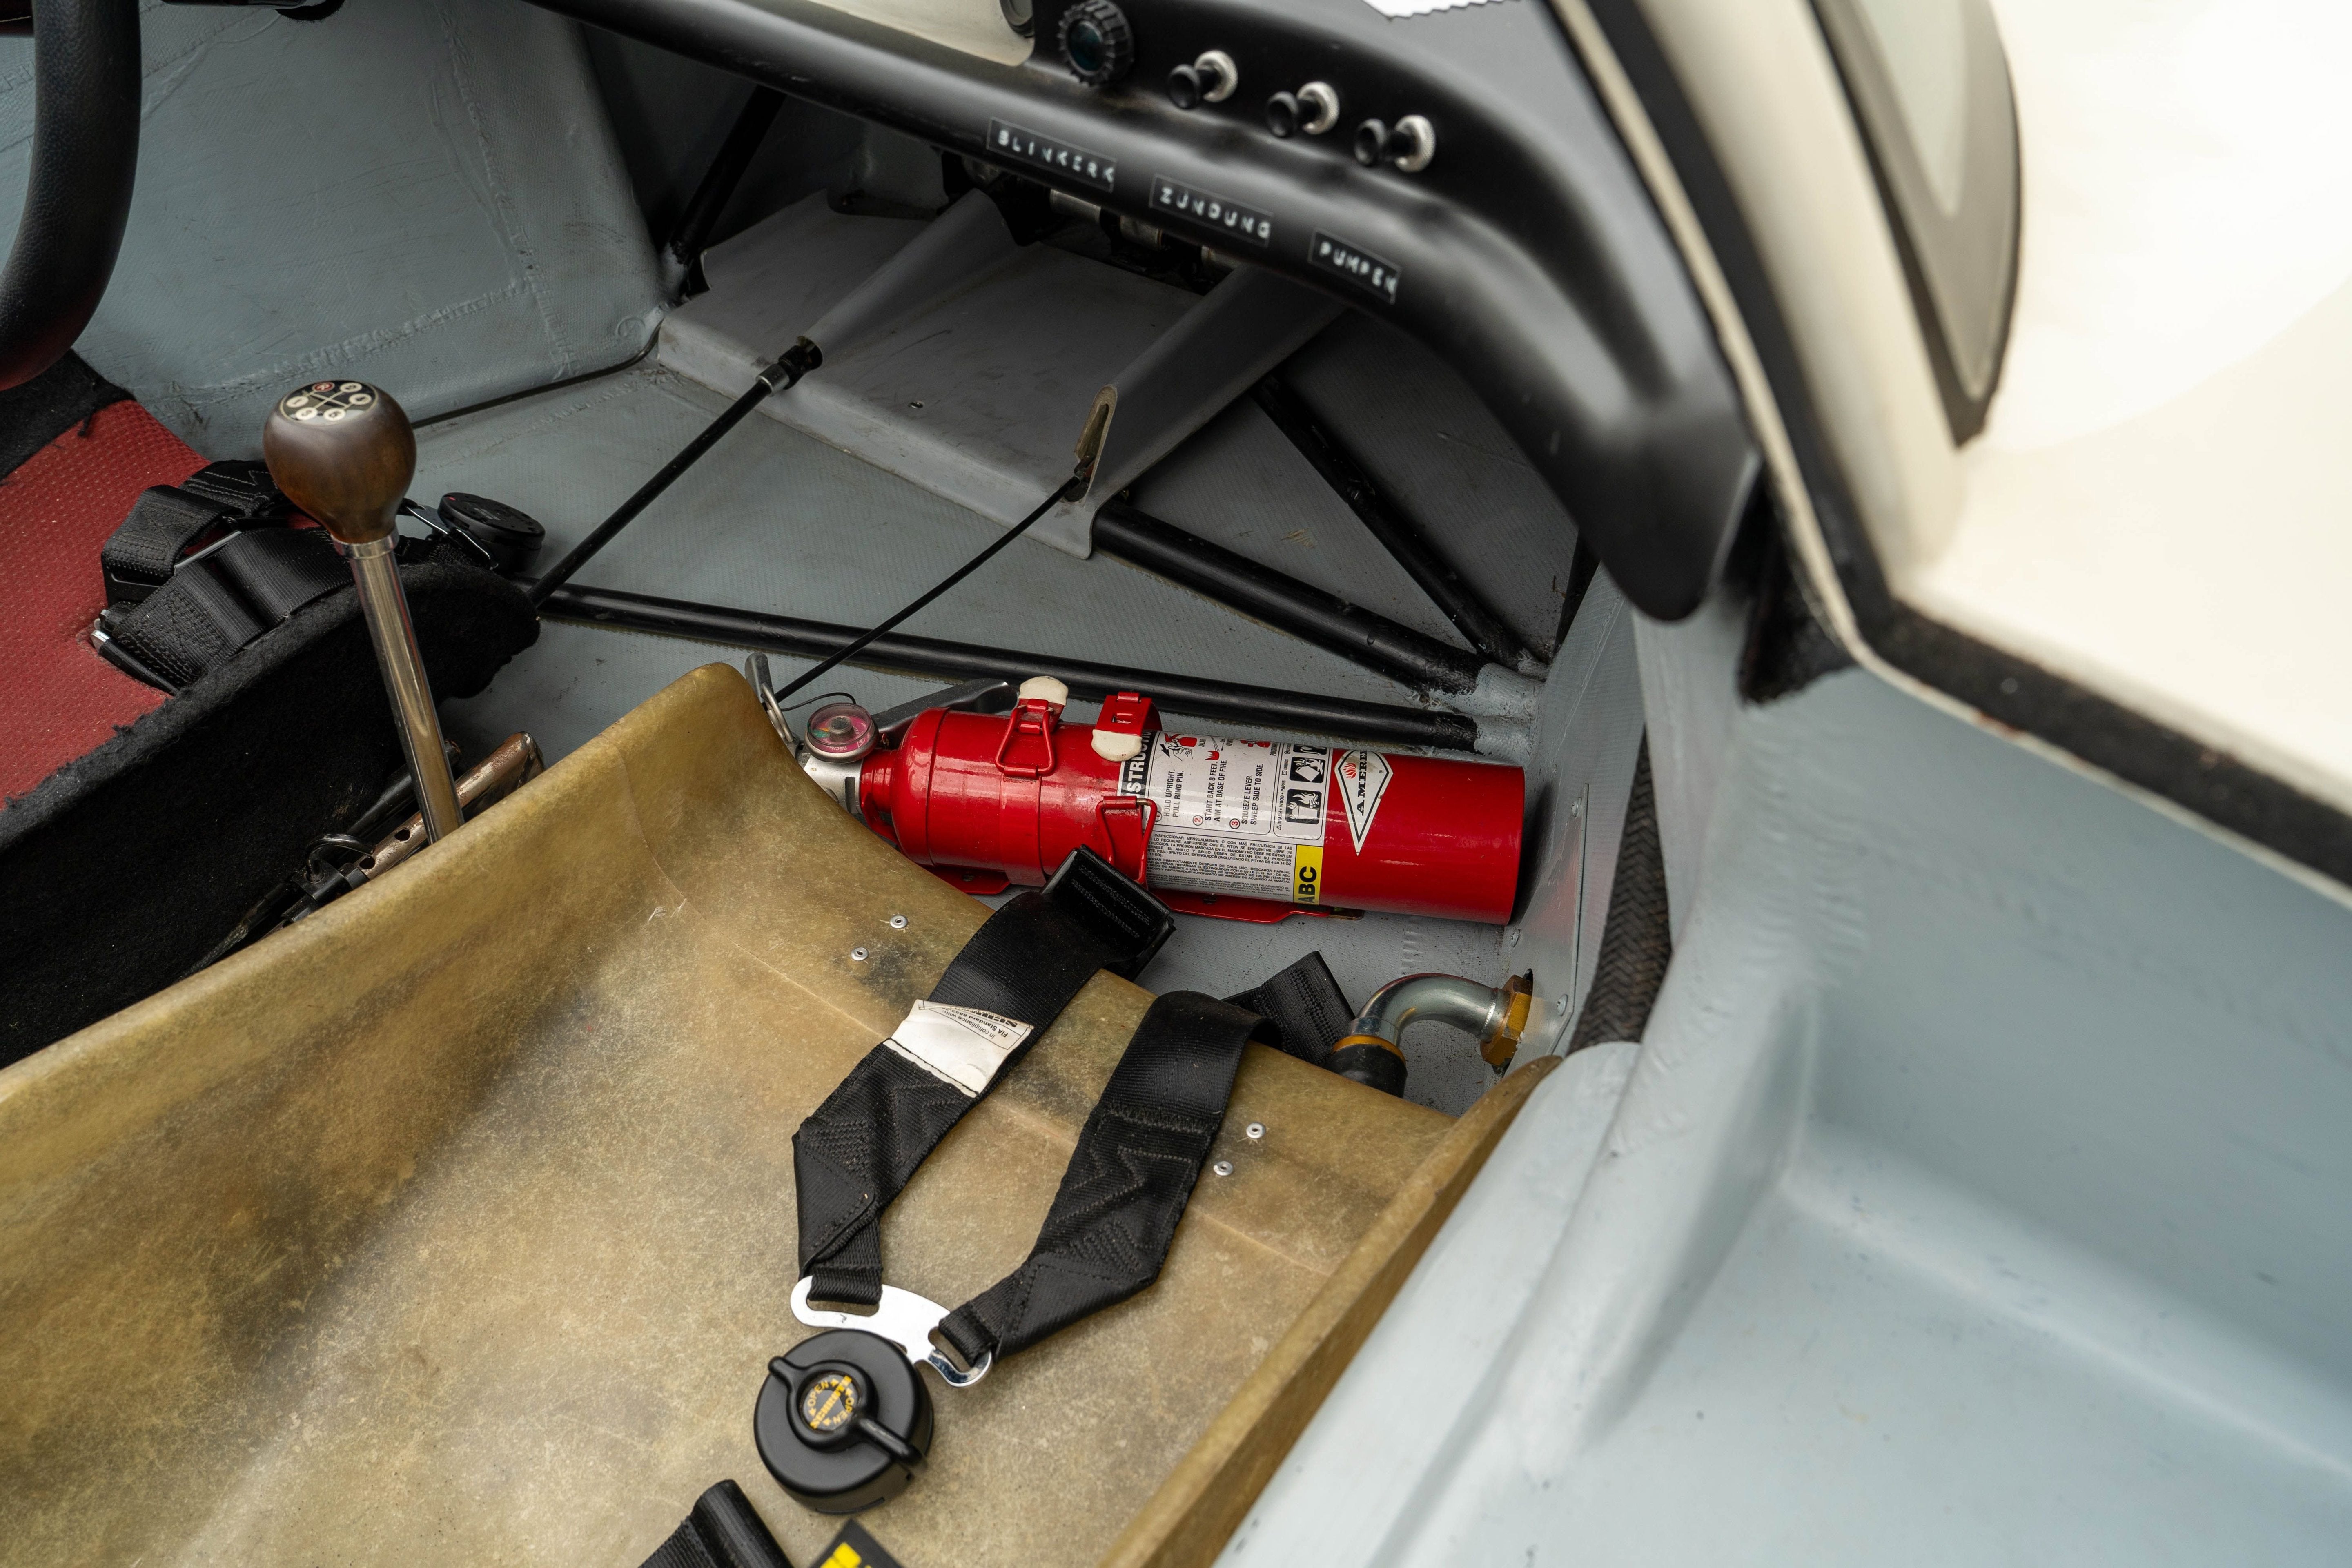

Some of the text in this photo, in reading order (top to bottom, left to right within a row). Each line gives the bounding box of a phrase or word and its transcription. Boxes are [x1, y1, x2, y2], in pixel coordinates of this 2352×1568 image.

[1165, 768, 1175, 797] UPRIGHT.
[1215, 799, 1221, 807] AT
[1241, 773, 1252, 824] SQUEEZE LEVER.
[1298, 866, 1317, 904] ABC
[958, 1016, 989, 1034] compliance
[968, 1015, 998, 1031] Standard
[997, 1028, 1008, 1038] FIA
